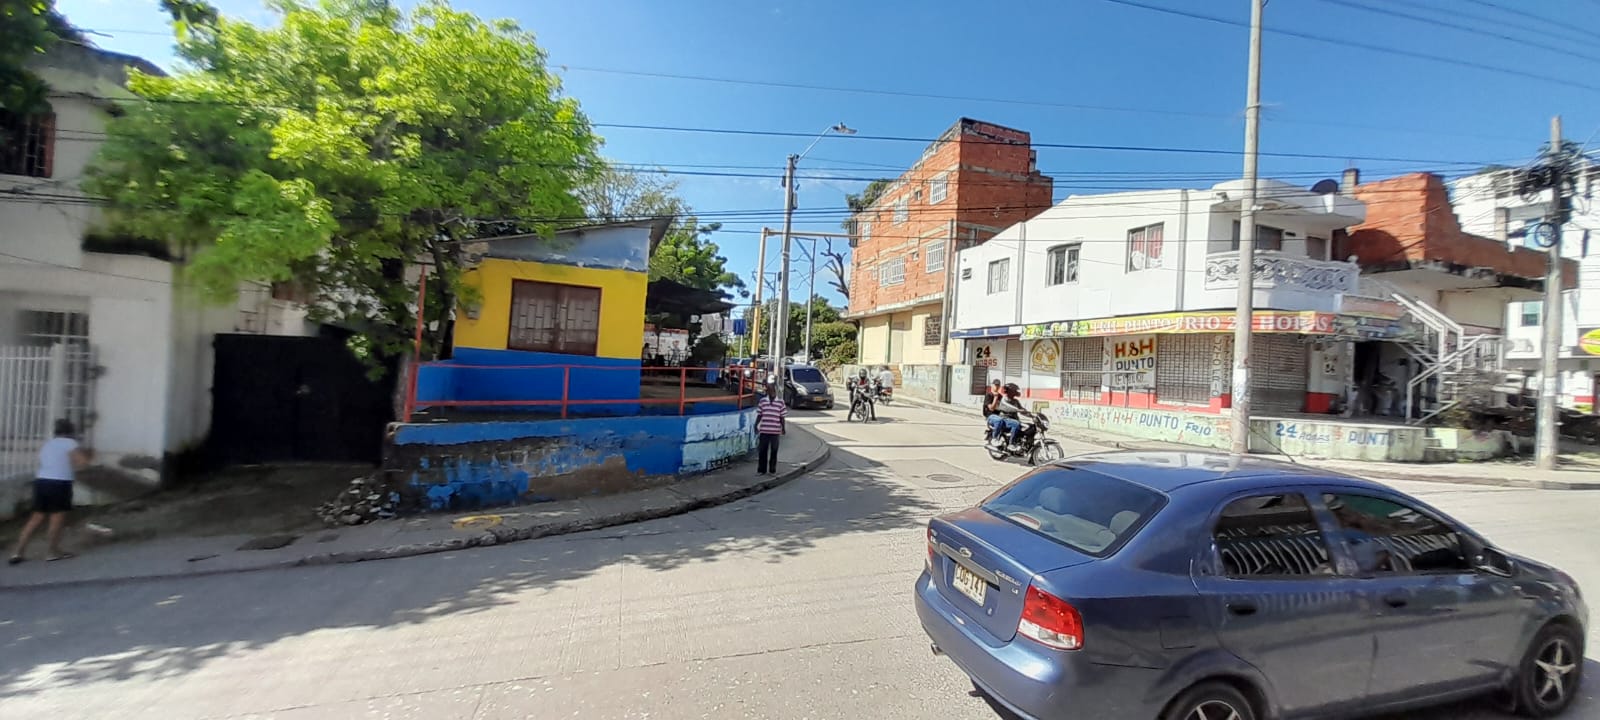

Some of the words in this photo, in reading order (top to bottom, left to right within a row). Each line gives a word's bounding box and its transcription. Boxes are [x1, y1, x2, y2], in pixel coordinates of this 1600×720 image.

[1174, 315, 1220, 330] FRIO
[976, 346, 991, 359] 24
[1115, 337, 1154, 359] H&H
[1116, 357, 1154, 371] PUNTO
[1139, 413, 1179, 430] PUNTO
[1185, 421, 1211, 436] FRIO
[1275, 423, 1297, 438] 24
